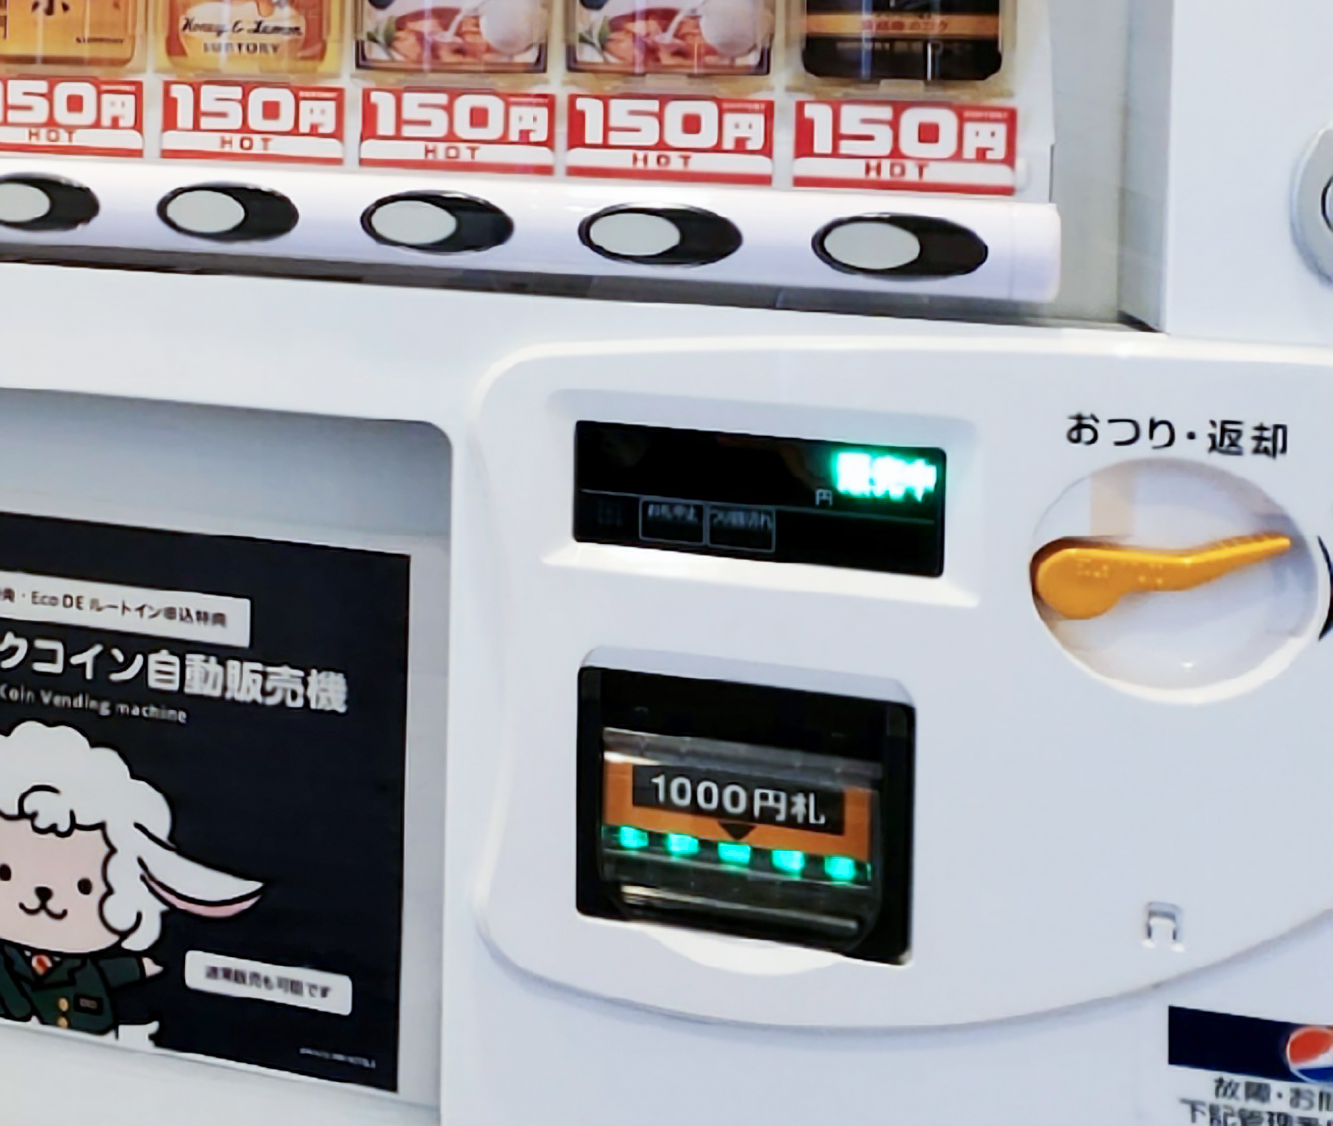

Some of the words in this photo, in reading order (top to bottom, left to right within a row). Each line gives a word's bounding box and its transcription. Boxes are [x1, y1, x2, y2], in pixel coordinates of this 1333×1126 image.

[181, 17, 224, 37] Honey
[246, 17, 303, 37] Lemon
[169, 85, 338, 134] 150円
[369, 90, 550, 142] 150円
[575, 98, 767, 150] 150円
[803, 103, 1008, 160] 150円
[27, 127, 78, 143] HOT
[220, 135, 273, 152] HOT
[424, 143, 481, 161] HOT
[633, 151, 692, 169] HOT
[864, 161, 929, 181] HOT
[1066, 411, 1290, 460] おつり・返却
[814, 489, 833, 507] 円
[31, 590, 60, 608] Eco
[62, 593, 84, 611] DE
[39, 687, 111, 717] Vending
[115, 700, 188, 724] machine
[649, 772, 827, 827] 1000円札
